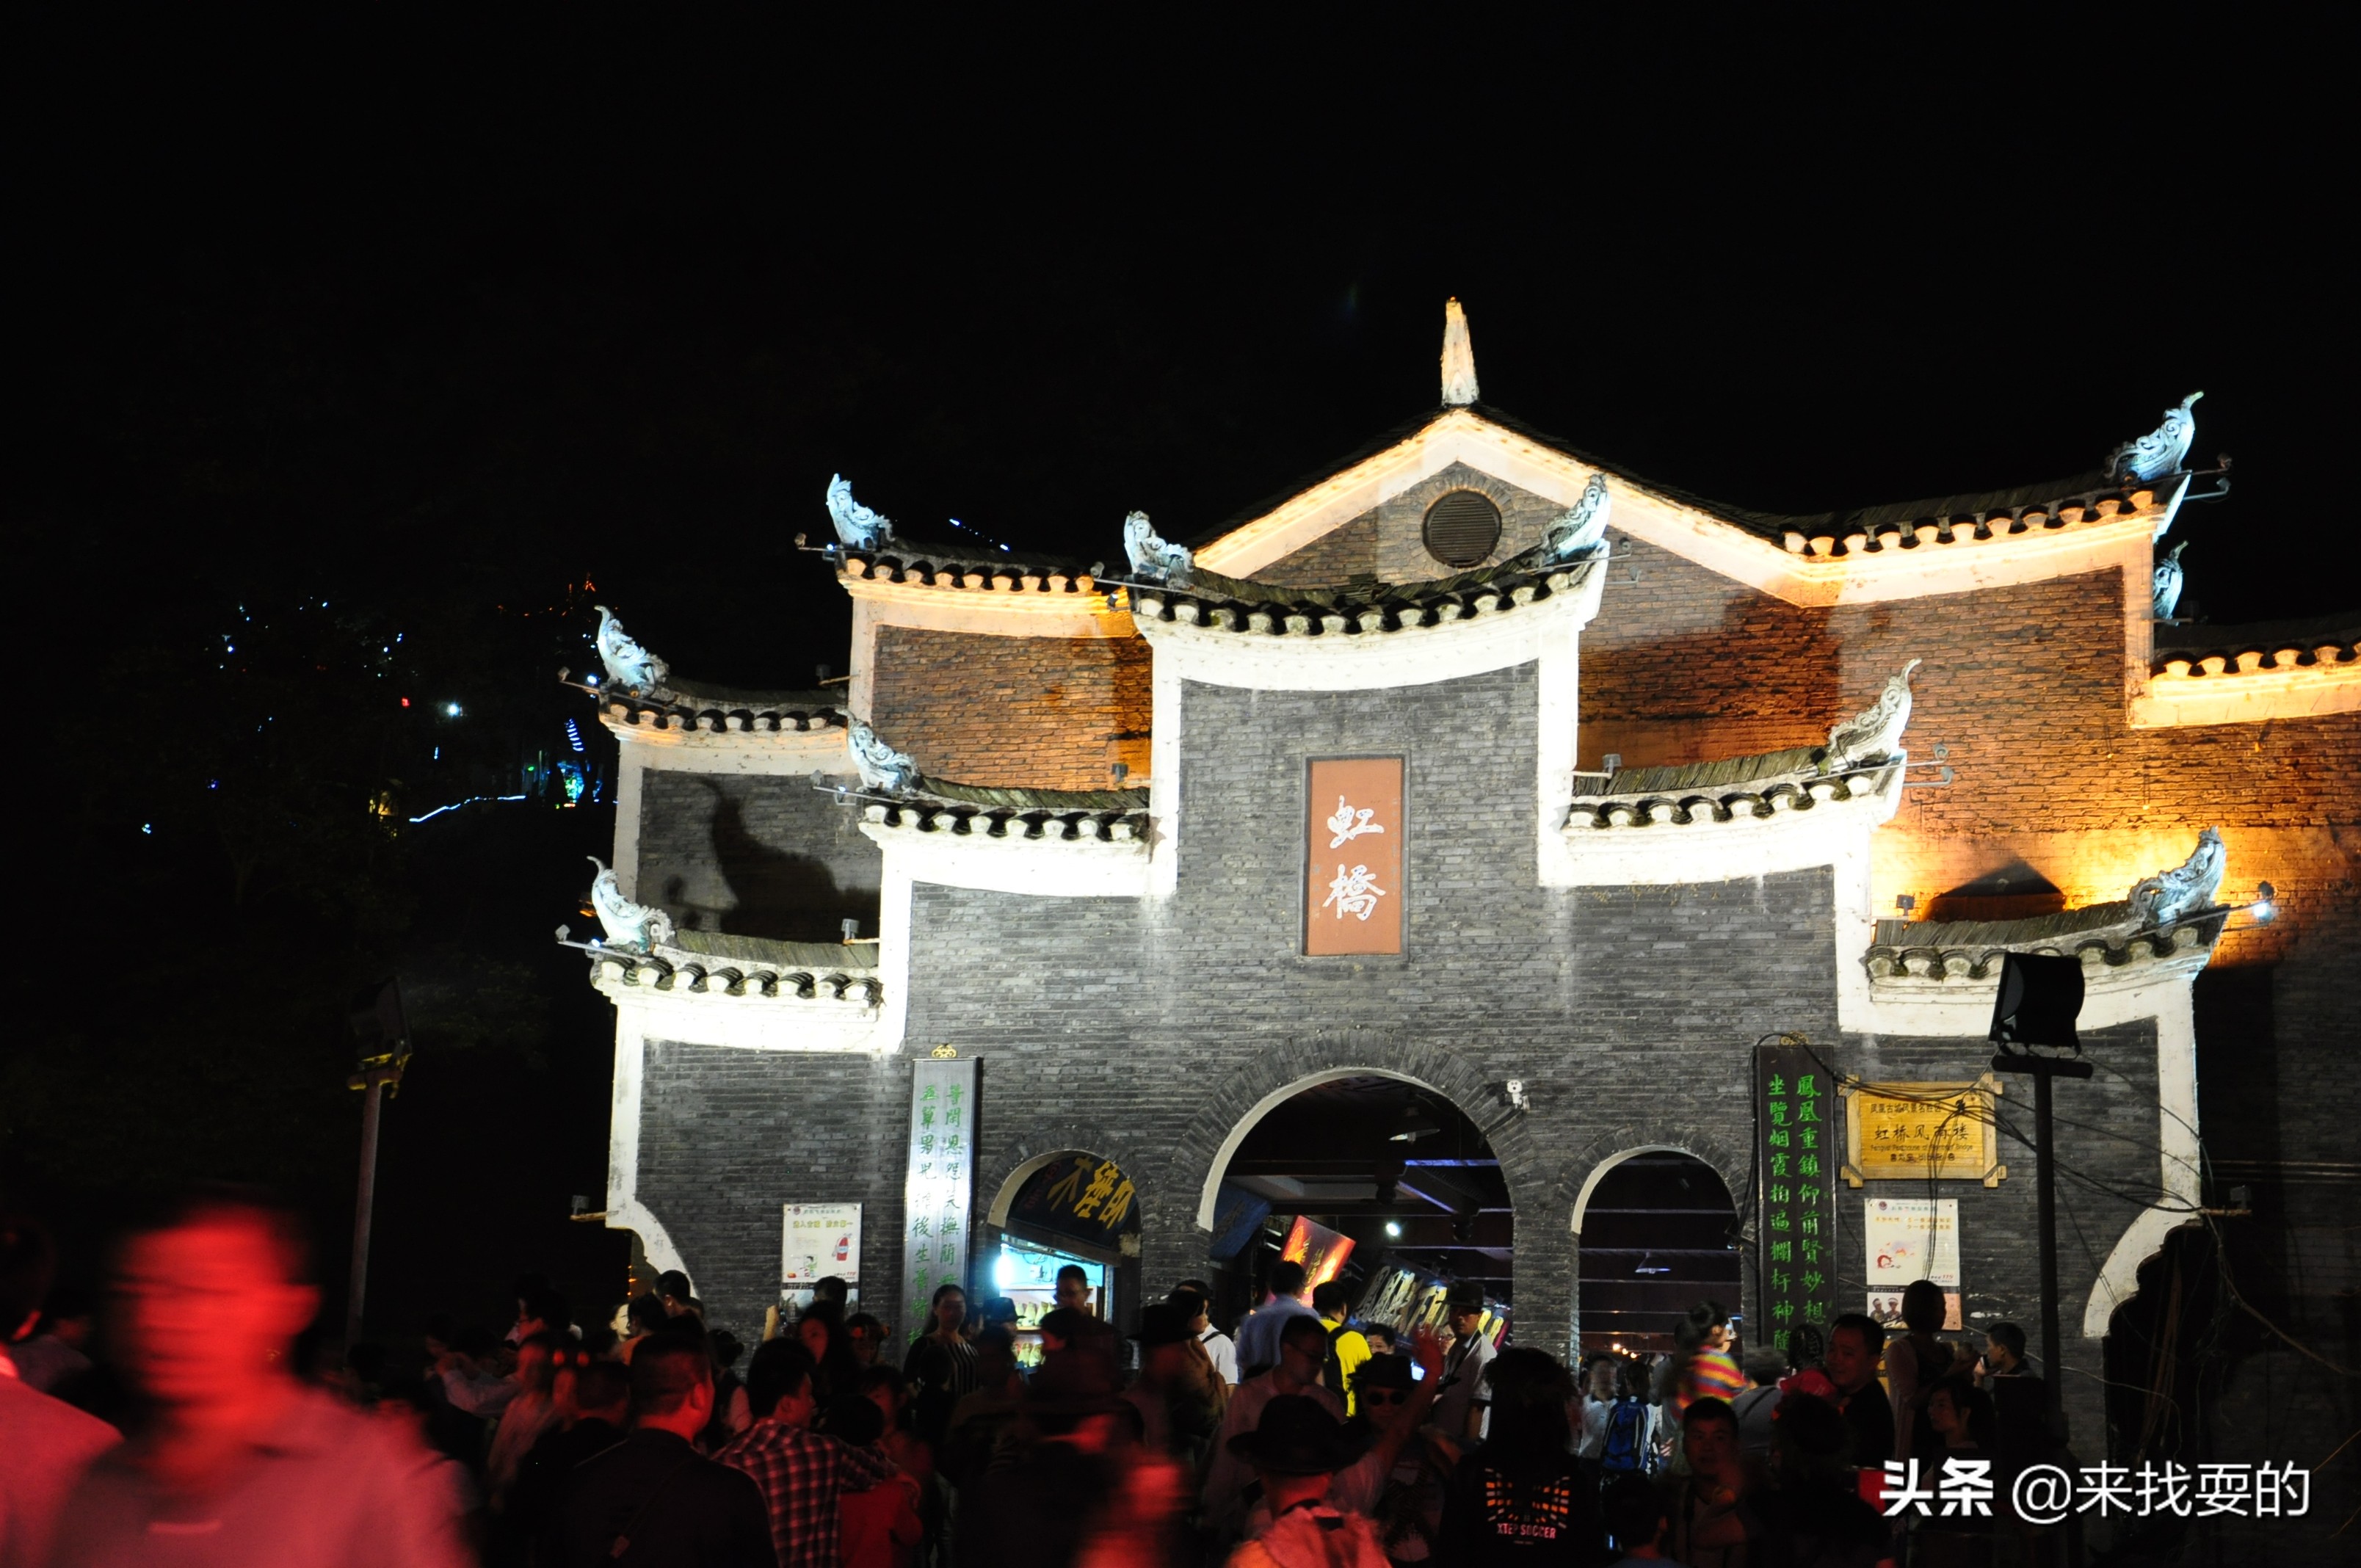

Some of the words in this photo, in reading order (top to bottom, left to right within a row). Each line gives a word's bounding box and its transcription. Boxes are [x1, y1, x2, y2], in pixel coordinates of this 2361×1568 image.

[1322, 794, 1386, 921] 虹橋
[1874, 1122, 1969, 1142] 虹桥风雨楼
[1520, 1524, 1556, 1539] SOCCER
